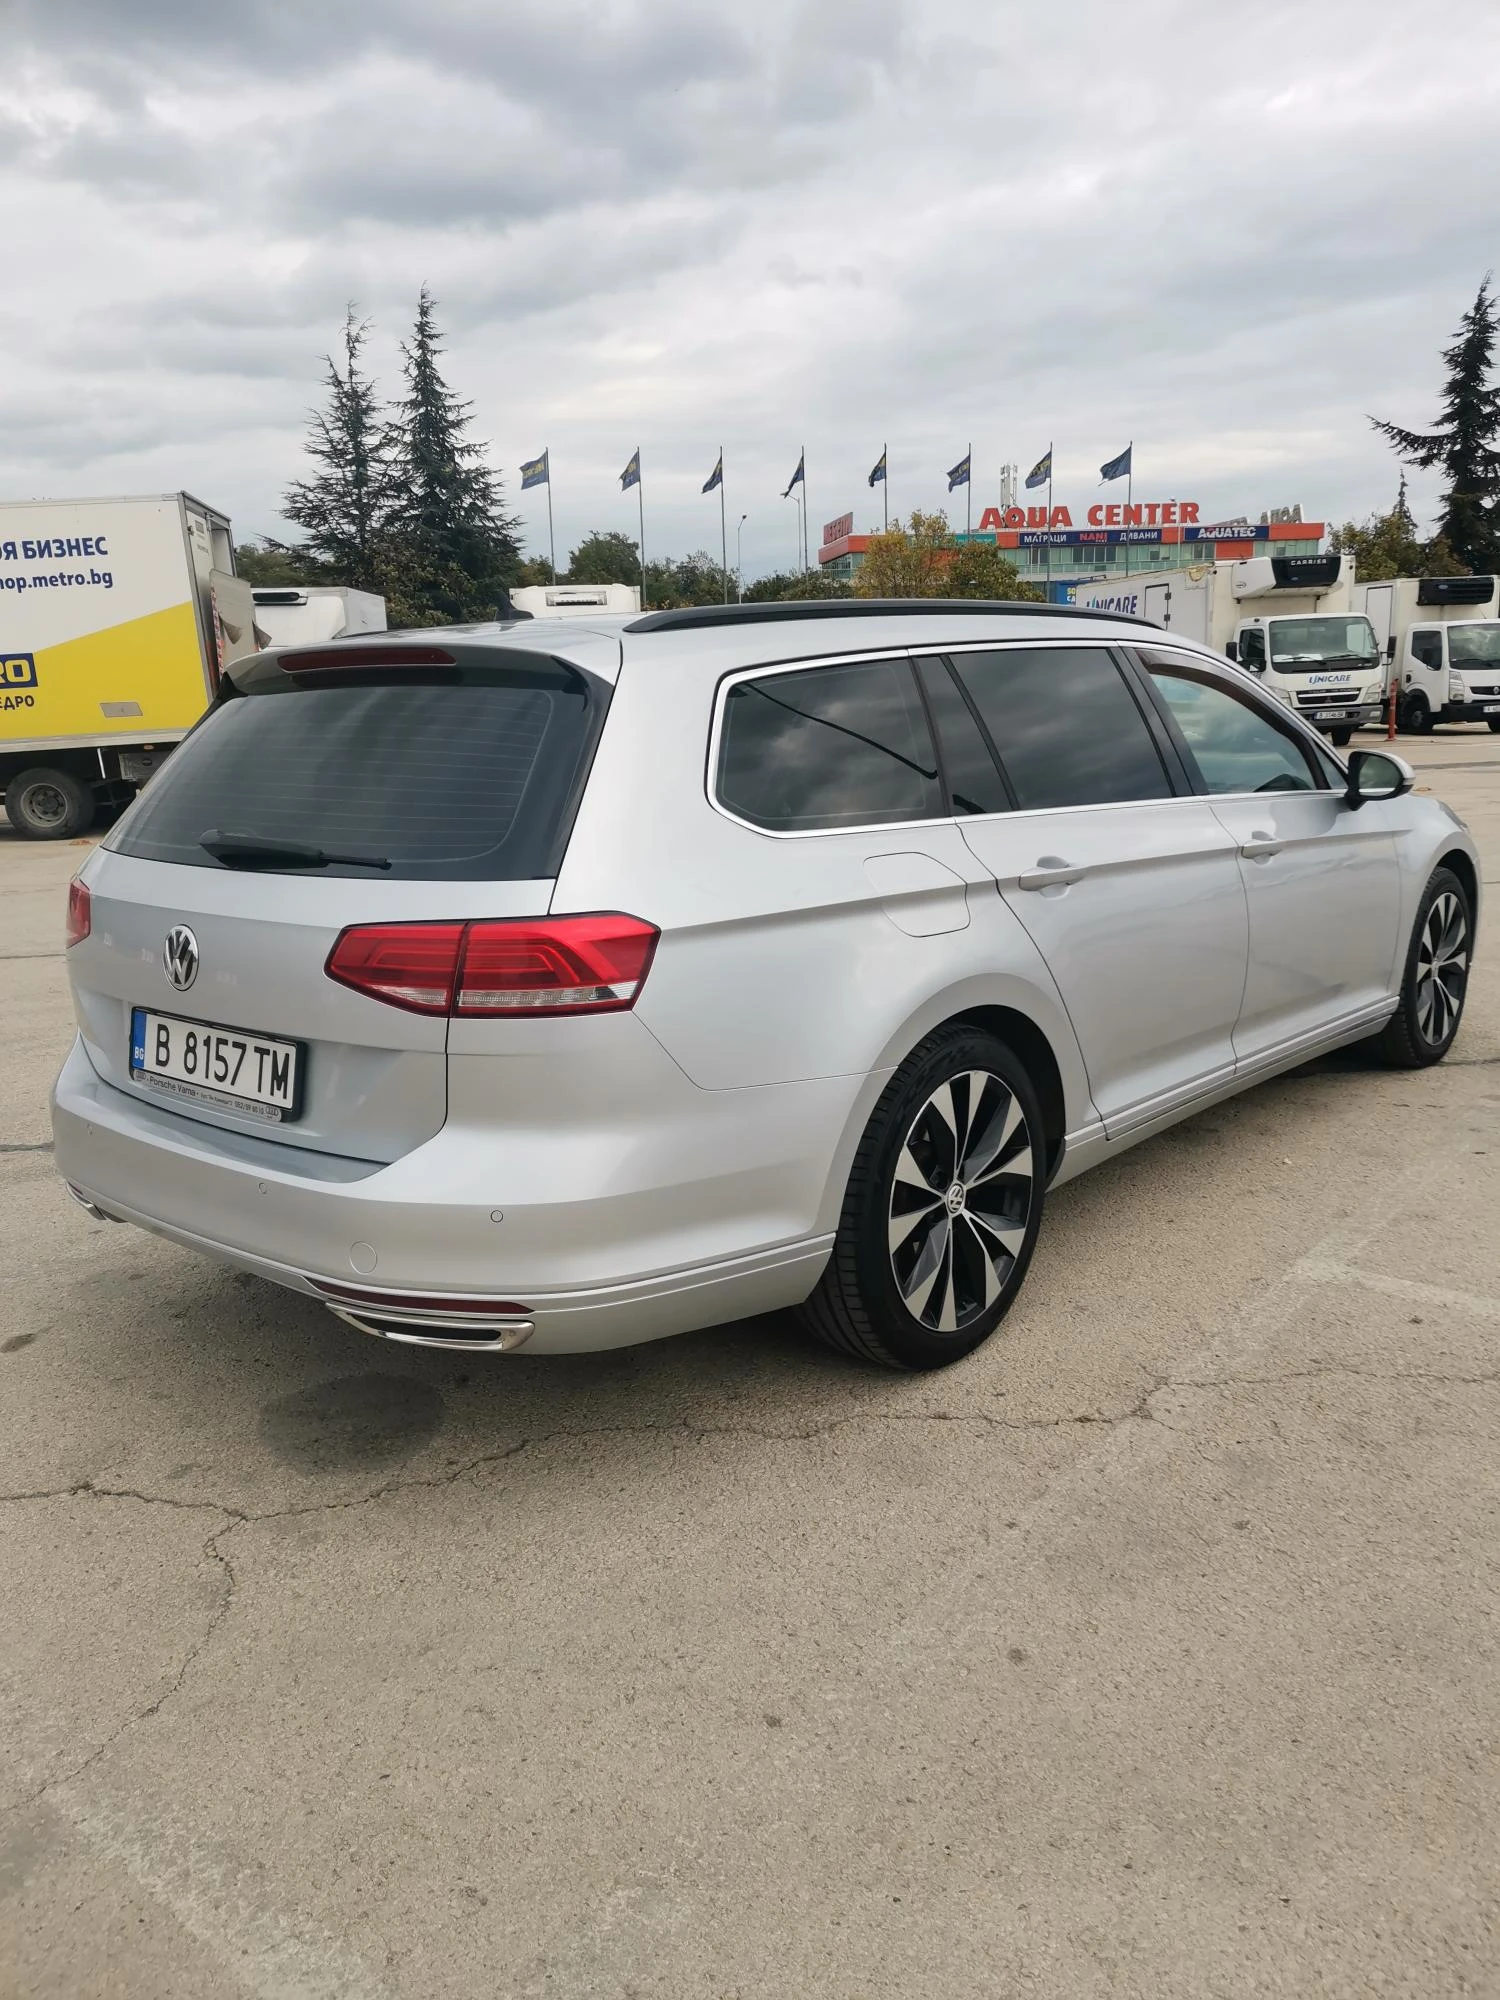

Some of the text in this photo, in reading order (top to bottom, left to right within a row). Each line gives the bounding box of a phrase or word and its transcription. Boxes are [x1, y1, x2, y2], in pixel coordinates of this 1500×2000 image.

[978, 502, 1200, 530] AQUA CENTER
[1119, 531, 1158, 542] ДИВАНИ
[1198, 526, 1257, 538] AQUATEC
[1024, 534, 1067, 544] МАТРАЦИ
[0, 536, 108, 560] Я БИЗНЕС
[1290, 558, 1327, 566] CARRIER
[1308, 674, 1351, 684] UNICARE
[134, 1046, 144, 1060] BG
[184, 1031, 247, 1086] 8157
[254, 1046, 290, 1099] TM
[149, 1075, 176, 1091] Porsche
